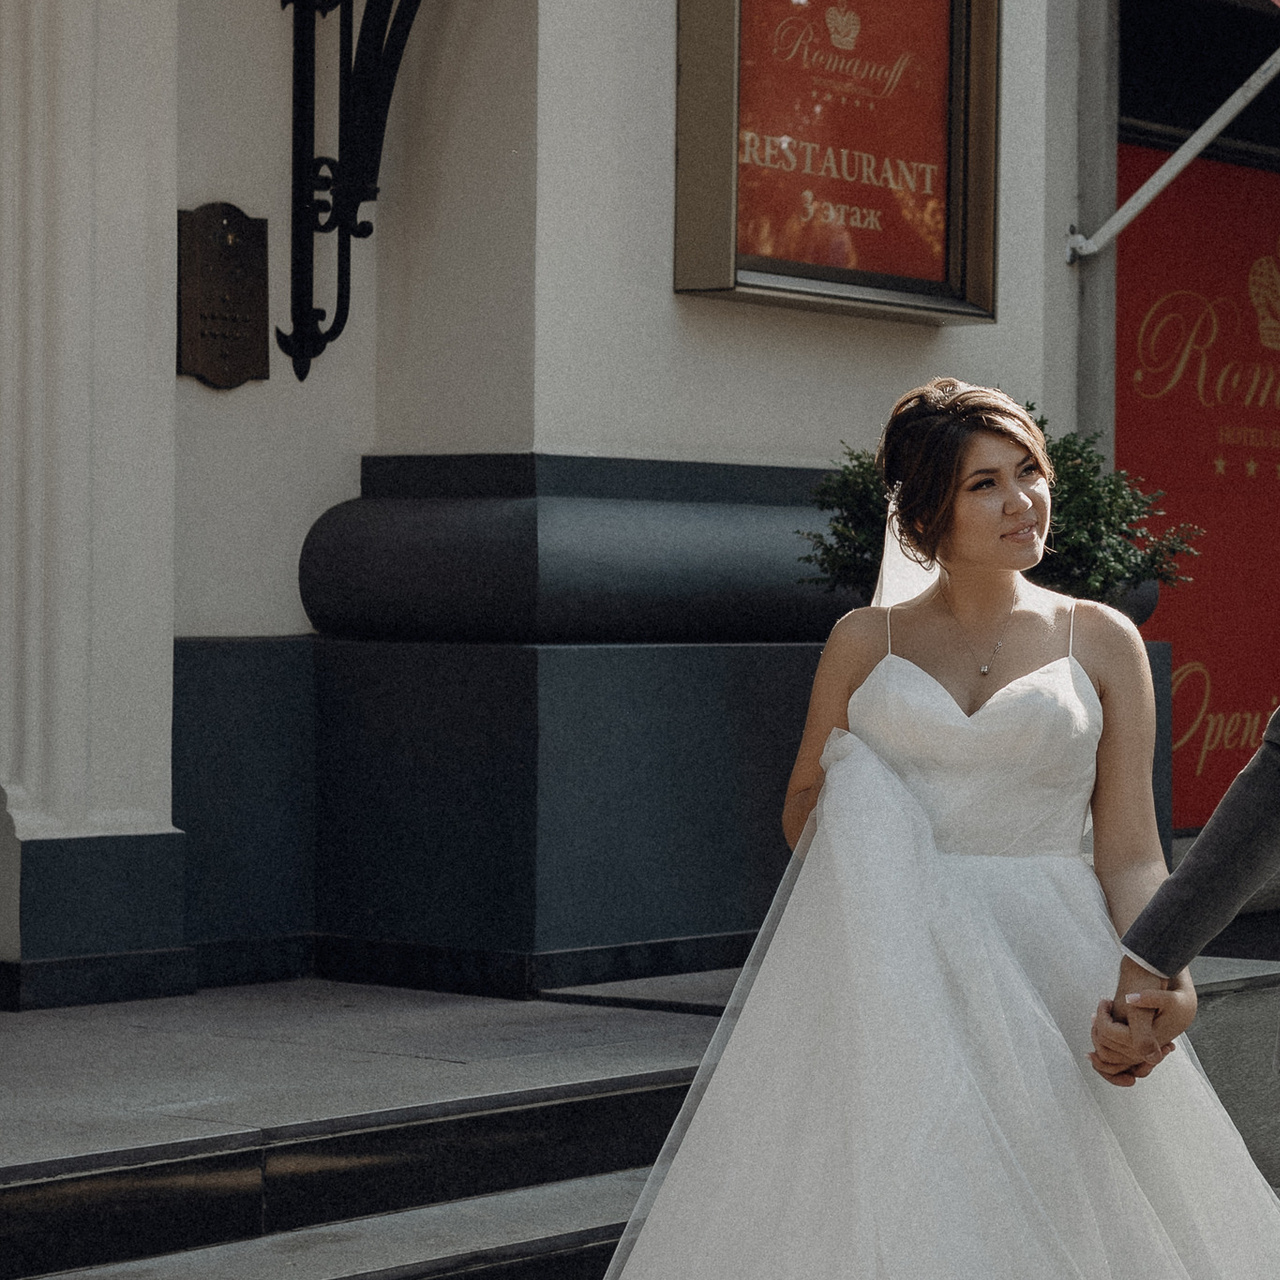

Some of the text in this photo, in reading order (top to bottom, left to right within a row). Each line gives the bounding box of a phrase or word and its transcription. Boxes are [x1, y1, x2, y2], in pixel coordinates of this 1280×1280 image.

[772, 16, 916, 98] Romanoff
[741, 131, 938, 195] RESTAURANT
[800, 190, 883, 231] 3 этаж
